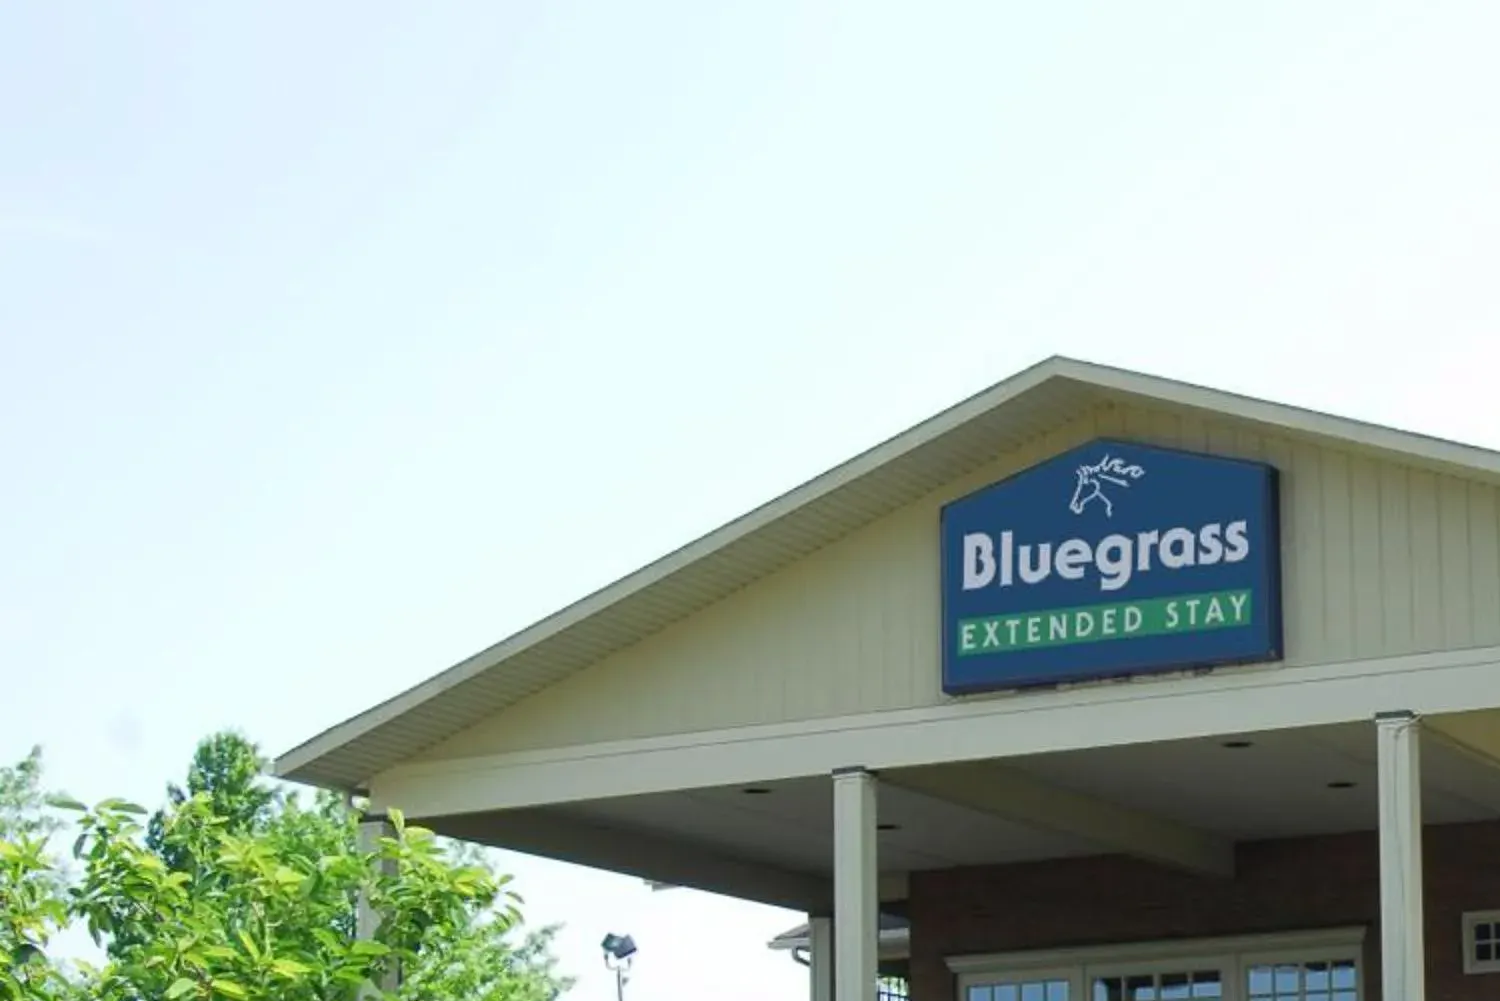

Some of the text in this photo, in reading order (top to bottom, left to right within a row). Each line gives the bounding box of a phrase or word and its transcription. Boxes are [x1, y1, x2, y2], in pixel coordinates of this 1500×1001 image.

[962, 520, 1249, 590] Bluegrass
[961, 594, 1247, 650] EXTENDED STAY
